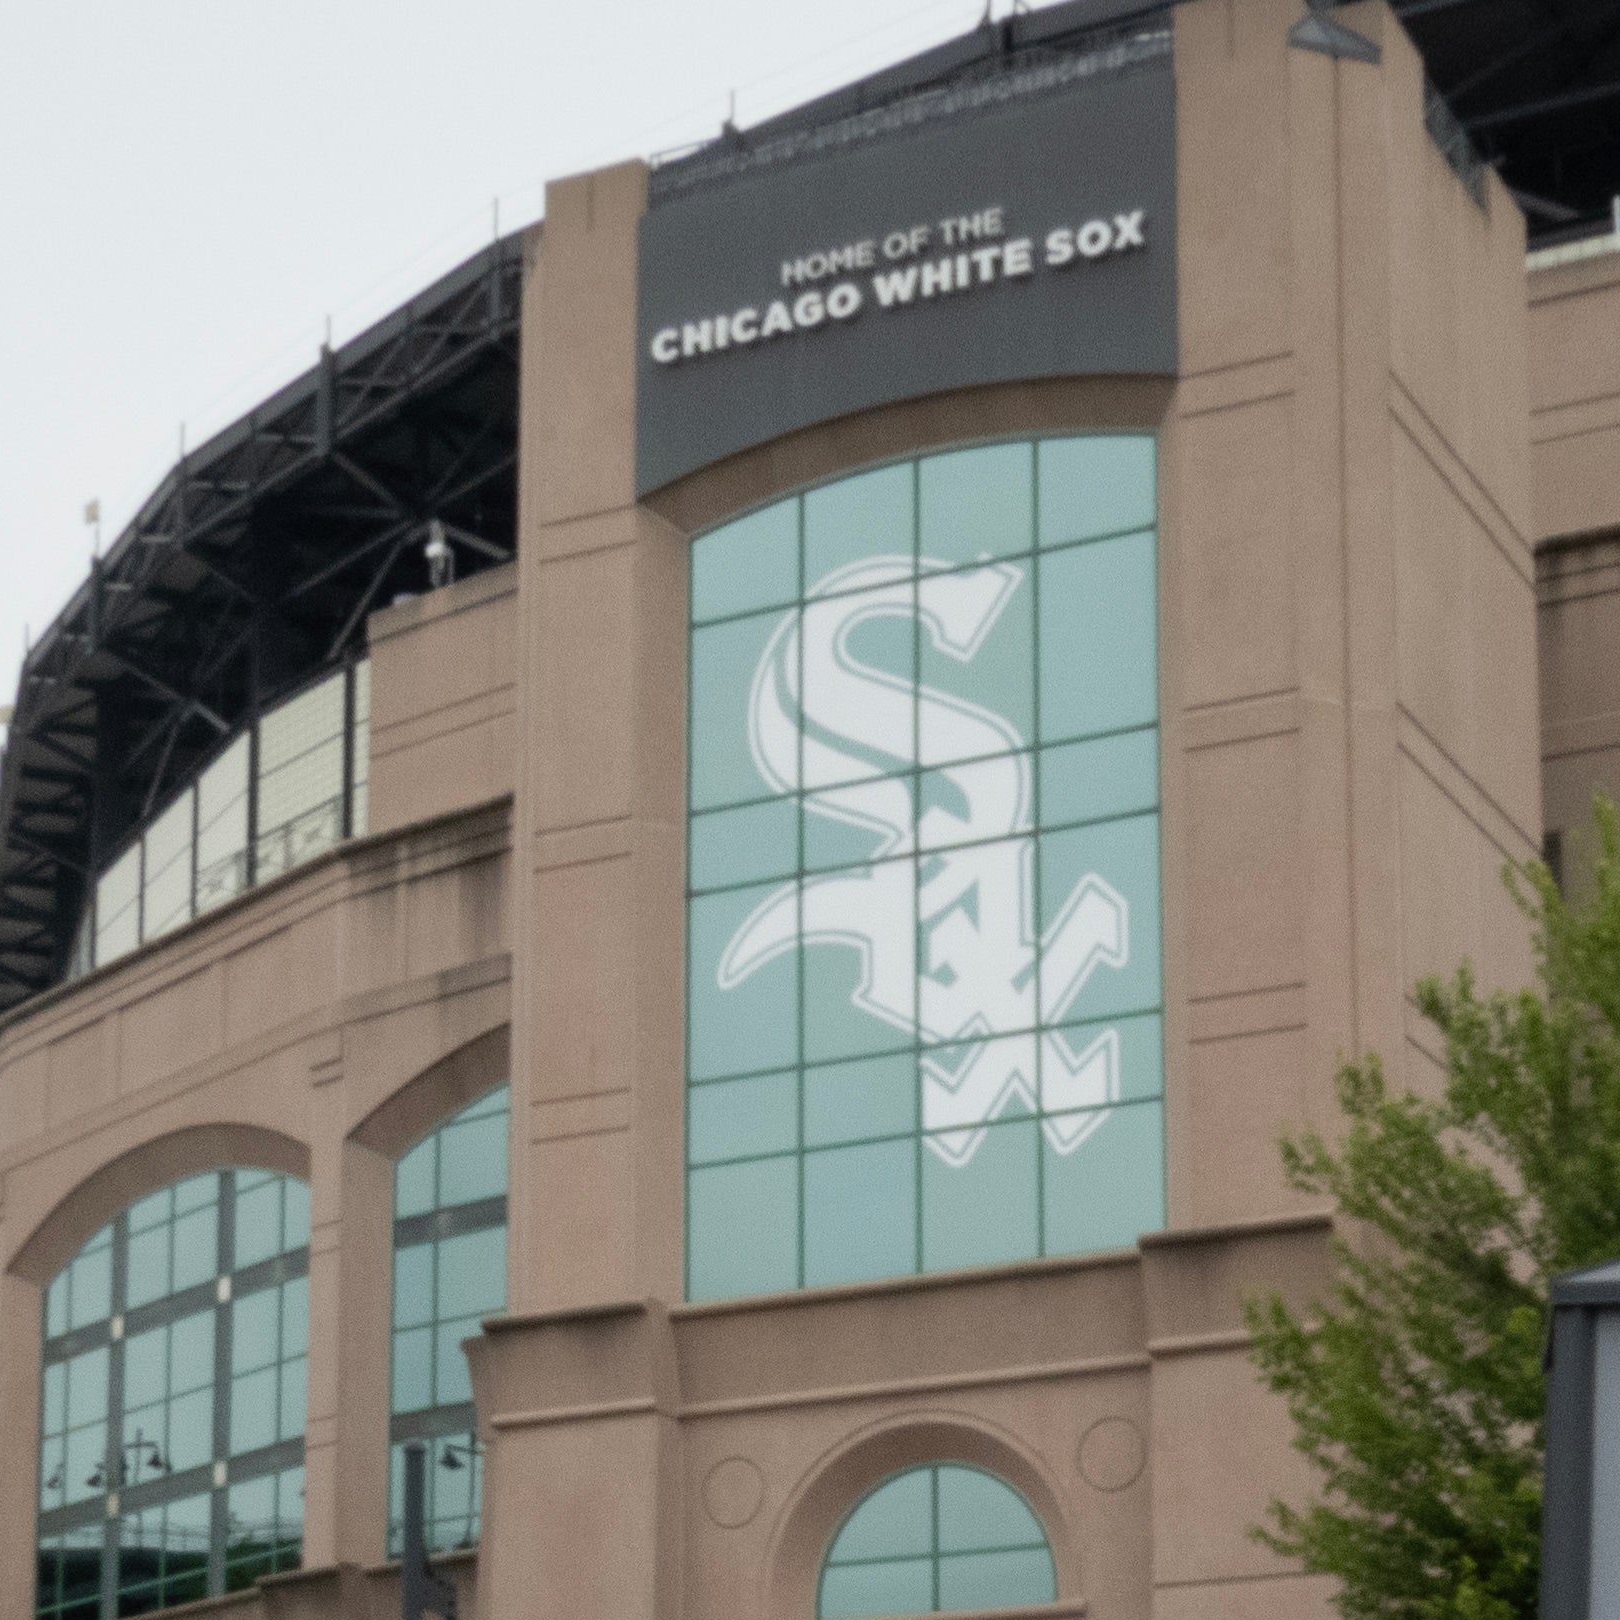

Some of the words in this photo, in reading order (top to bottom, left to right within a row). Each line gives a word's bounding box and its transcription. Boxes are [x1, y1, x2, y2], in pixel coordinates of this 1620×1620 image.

[651, 283, 862, 364] CHICAGO
[873, 238, 1033, 308] WHITE
[1045, 209, 1145, 266] SOX
[781, 239, 876, 287] HOME
[882, 225, 933, 260] OF
[939, 207, 1003, 246] THE
